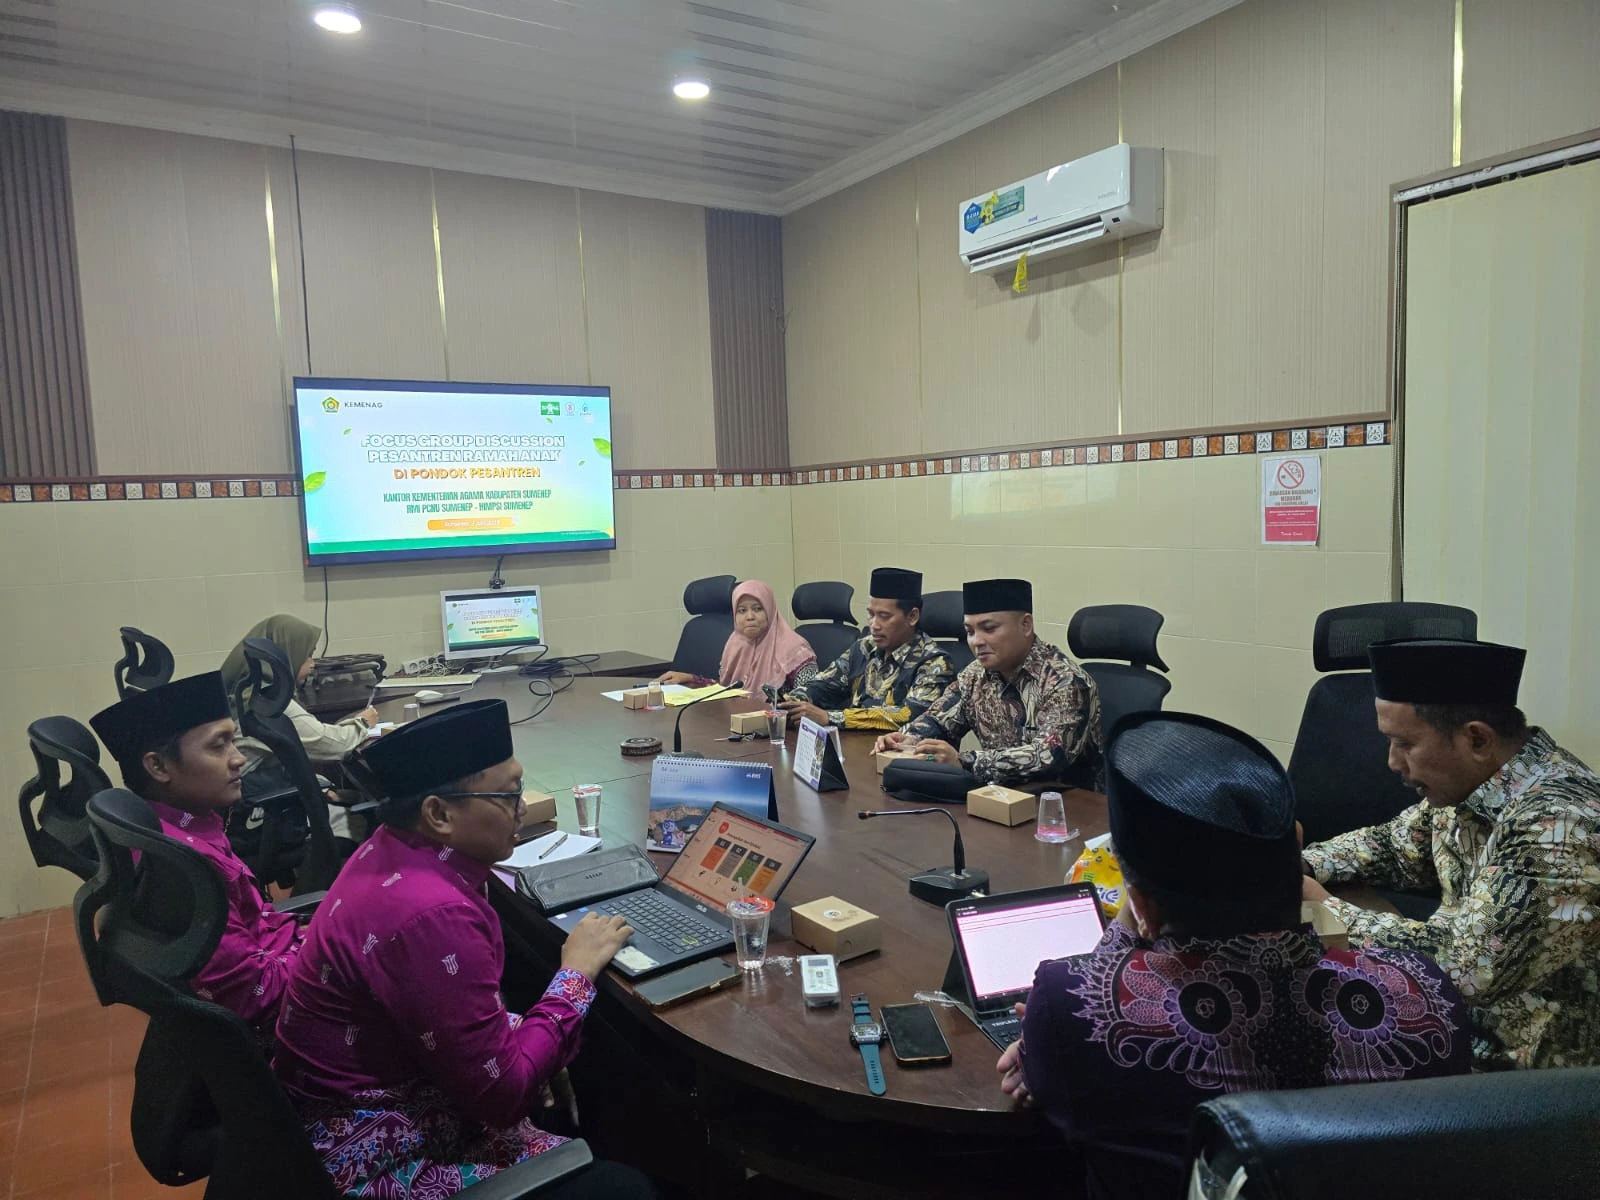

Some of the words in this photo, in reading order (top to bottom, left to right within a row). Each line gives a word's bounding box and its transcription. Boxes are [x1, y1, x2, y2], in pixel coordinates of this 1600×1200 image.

[344, 401, 384, 409] KEMENAG
[361, 433, 417, 448] FOCUS
[418, 434, 474, 447] GROUP
[475, 434, 565, 447] DISCUSSION
[368, 450, 462, 463] PESANTREN
[463, 450, 519, 462] RAMAH
[520, 449, 561, 462] ANAK
[394, 468, 408, 480] DI
[410, 467, 467, 479] PONDOK
[469, 466, 541, 479] PESANTREN
[383, 493, 411, 502] KANTOR
[460, 491, 484, 500] AGAMA
[485, 490, 522, 500] KABUPATEN
[522, 489, 552, 499] SUMENEP
[441, 502, 473, 512] SUMENEP
[503, 501, 533, 510] SUMENEP
